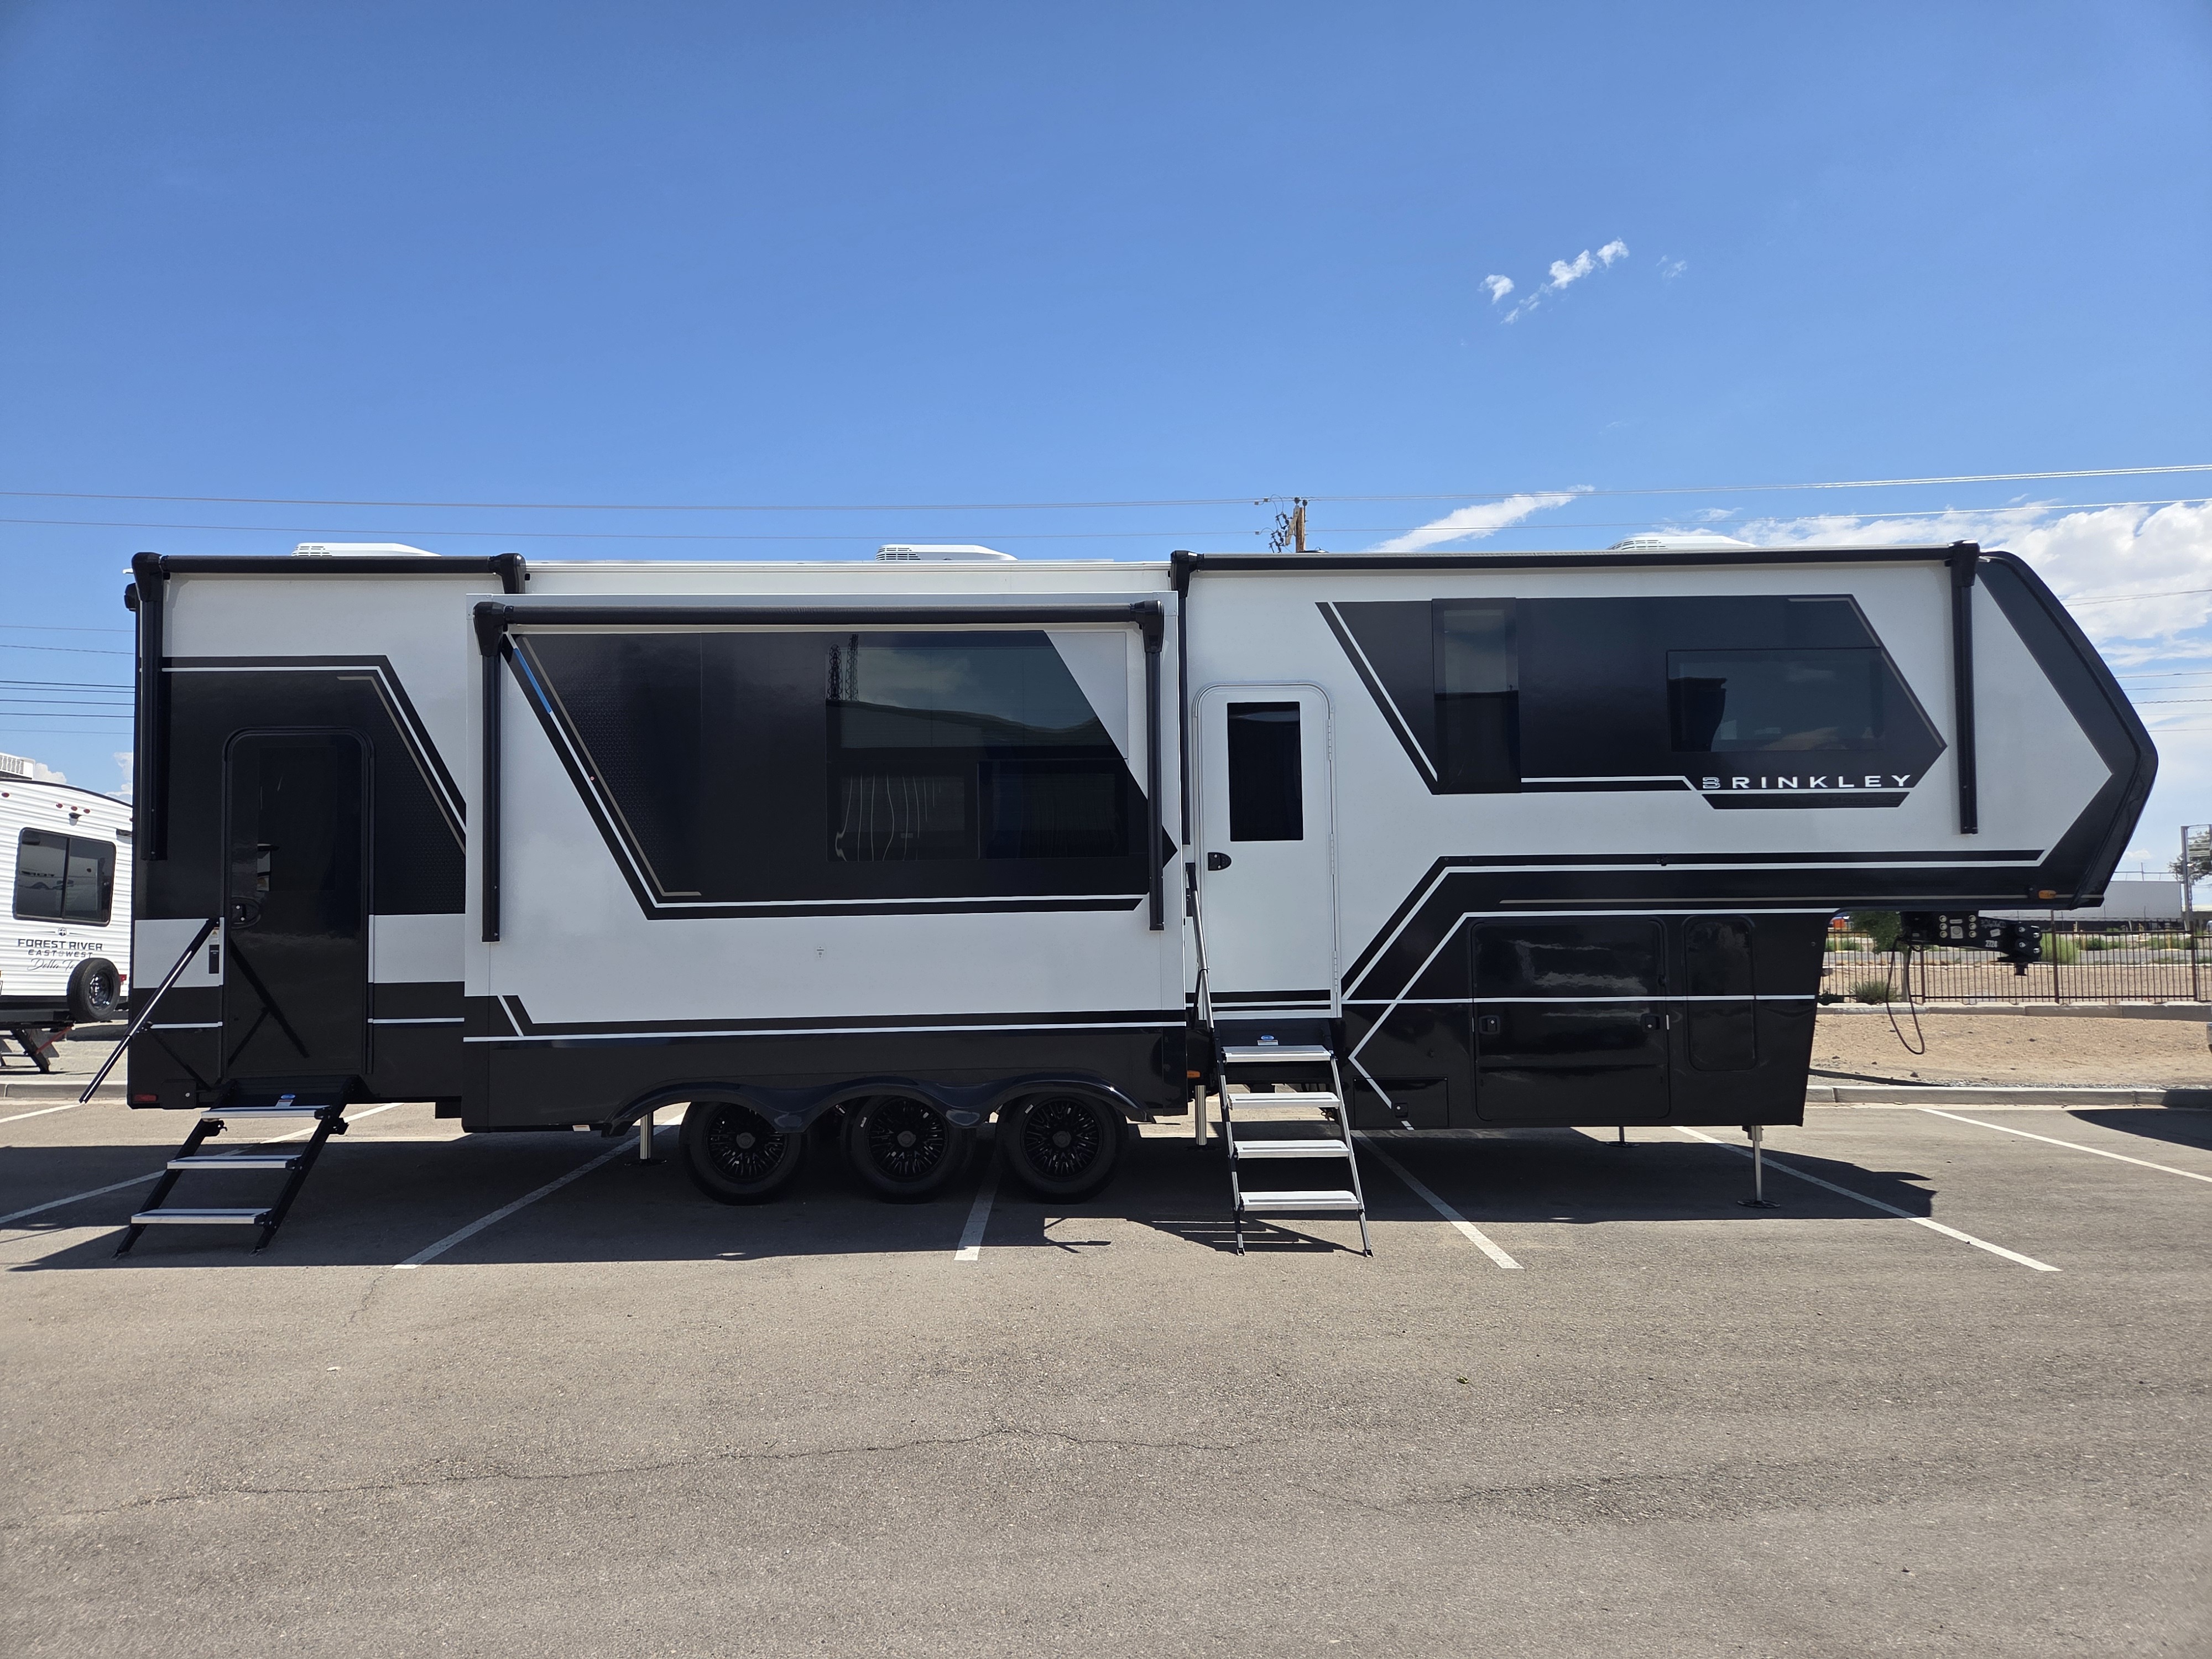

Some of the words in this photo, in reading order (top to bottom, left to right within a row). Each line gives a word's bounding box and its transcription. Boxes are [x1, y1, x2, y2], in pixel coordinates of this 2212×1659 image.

[1702, 774, 1911, 789] BRINKLEY
[18, 938, 66, 949] FOREST
[69, 941, 103, 951] RIVER
